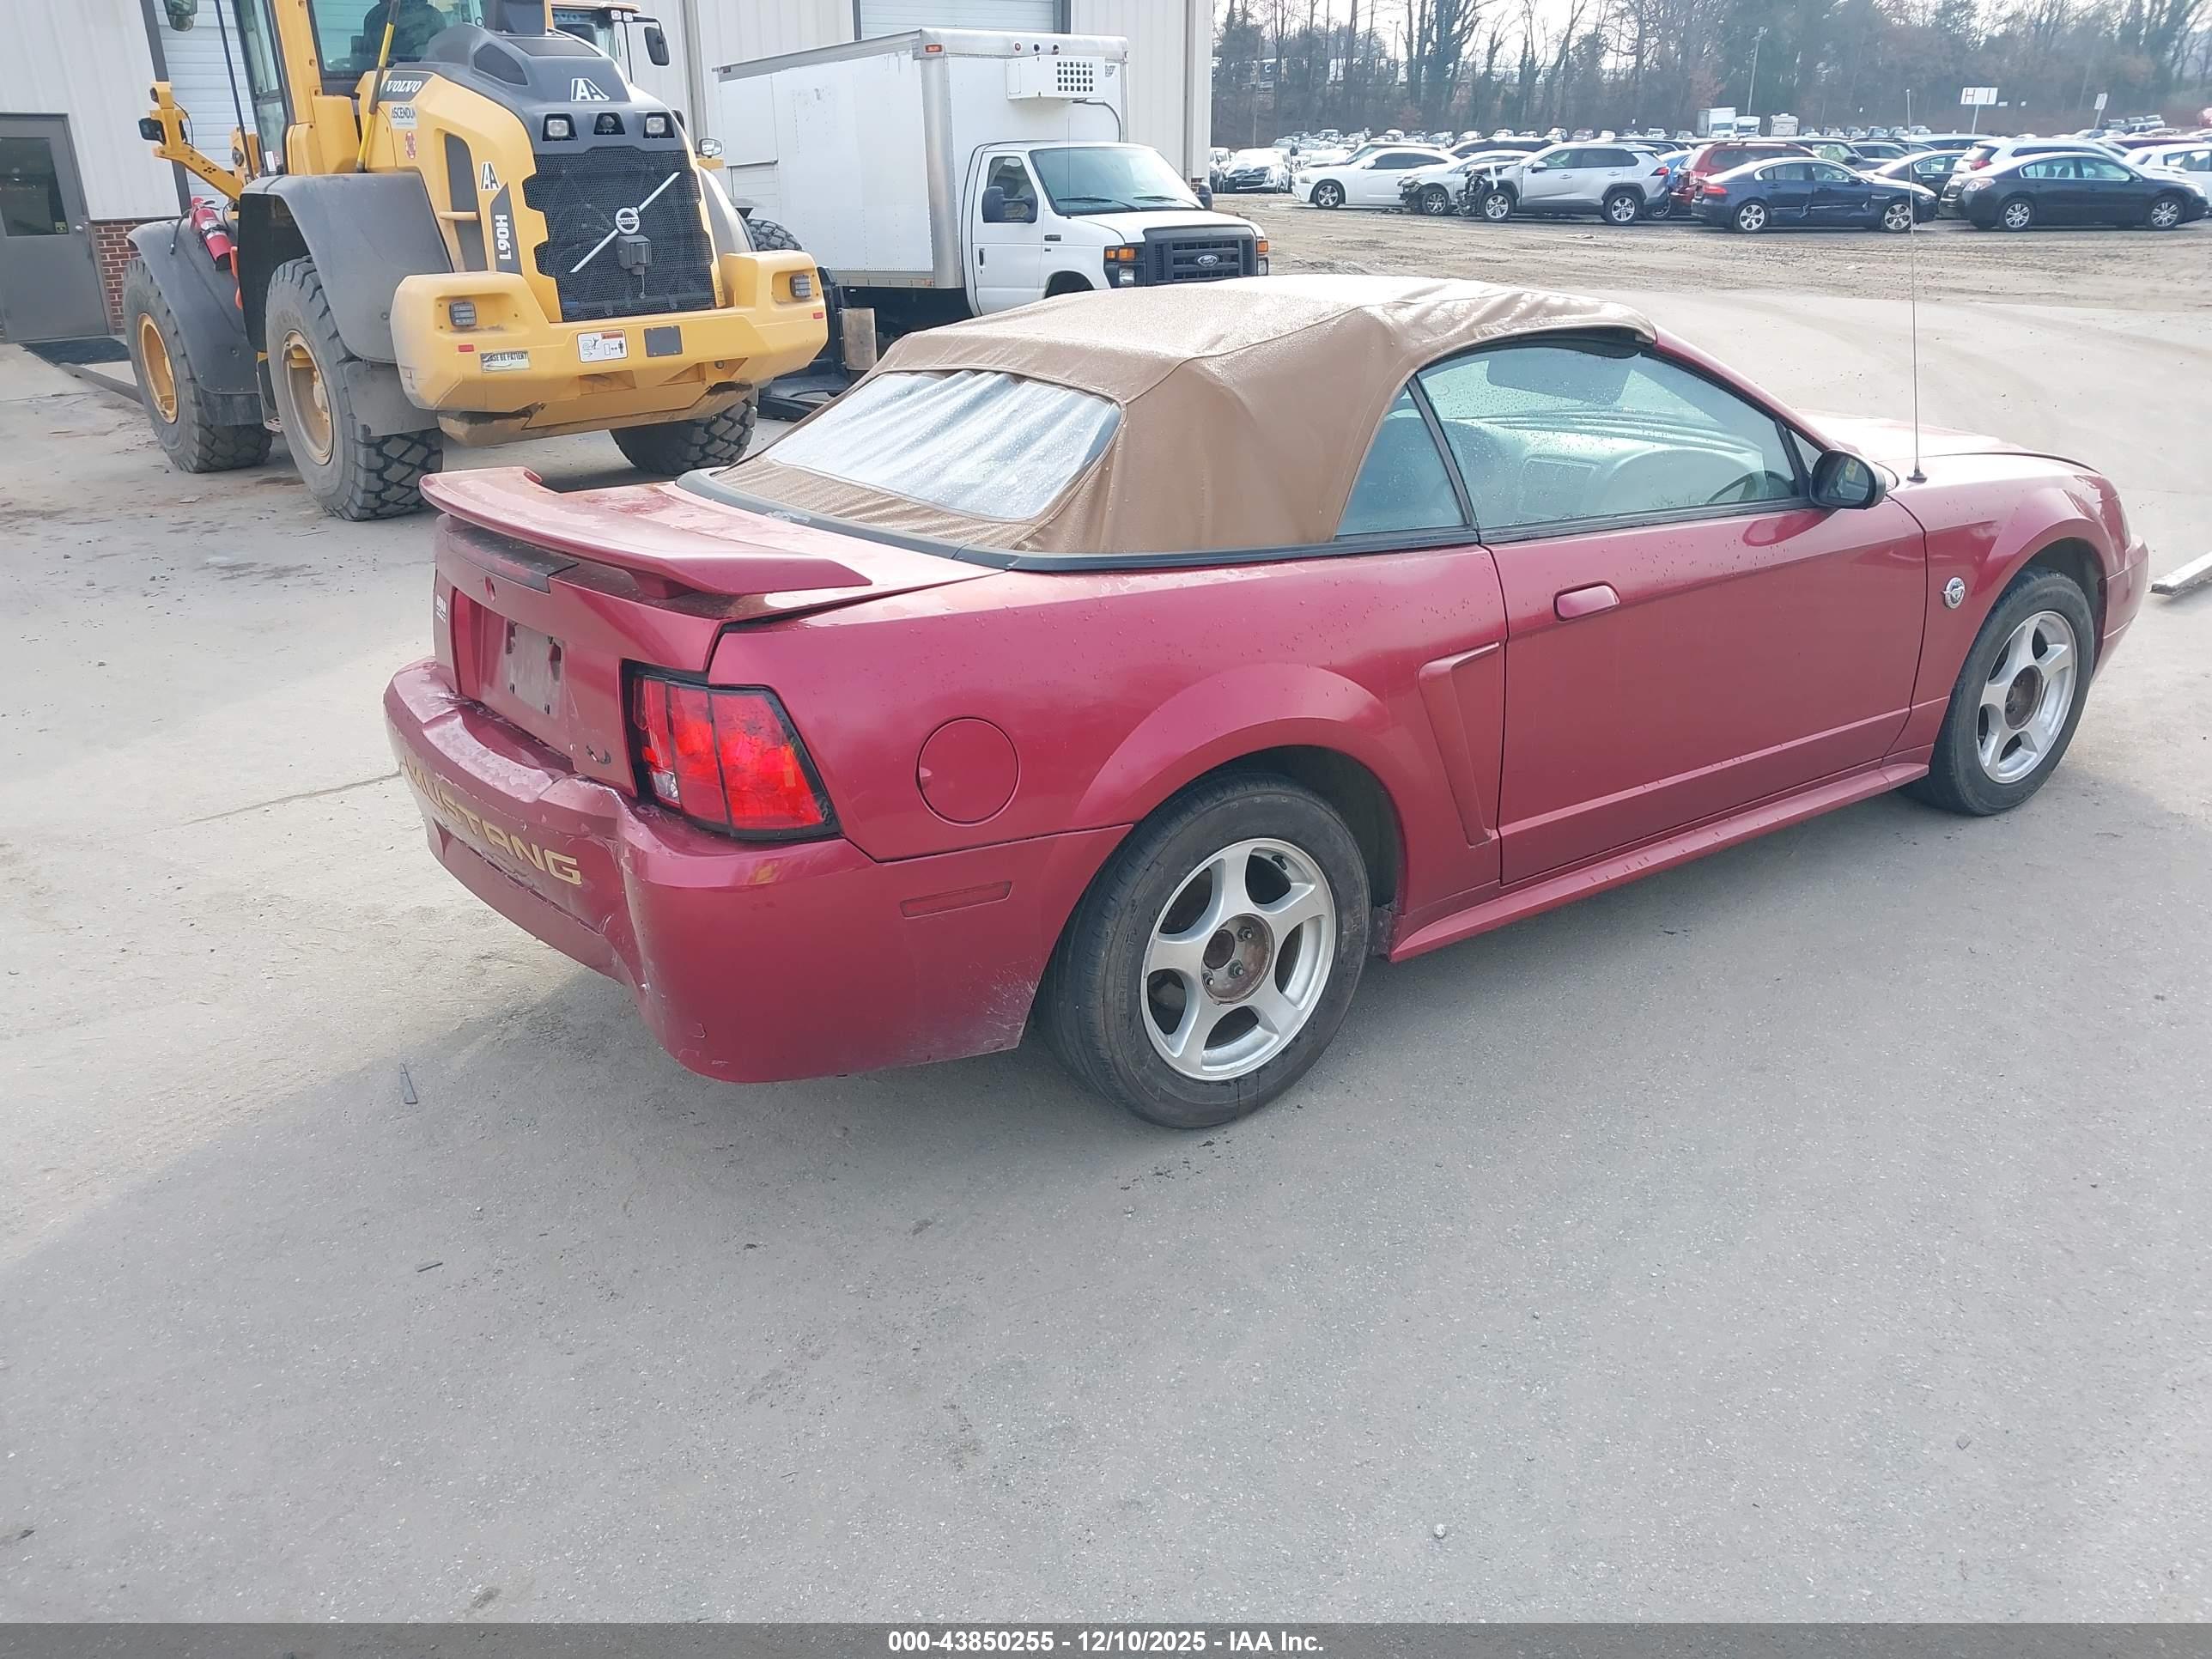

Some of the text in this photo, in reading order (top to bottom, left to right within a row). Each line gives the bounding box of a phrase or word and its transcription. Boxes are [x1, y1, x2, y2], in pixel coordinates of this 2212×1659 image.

[386, 80, 423, 93] VOLVO
[495, 214, 512, 259] L90H
[404, 755, 582, 886] MUSTANG
